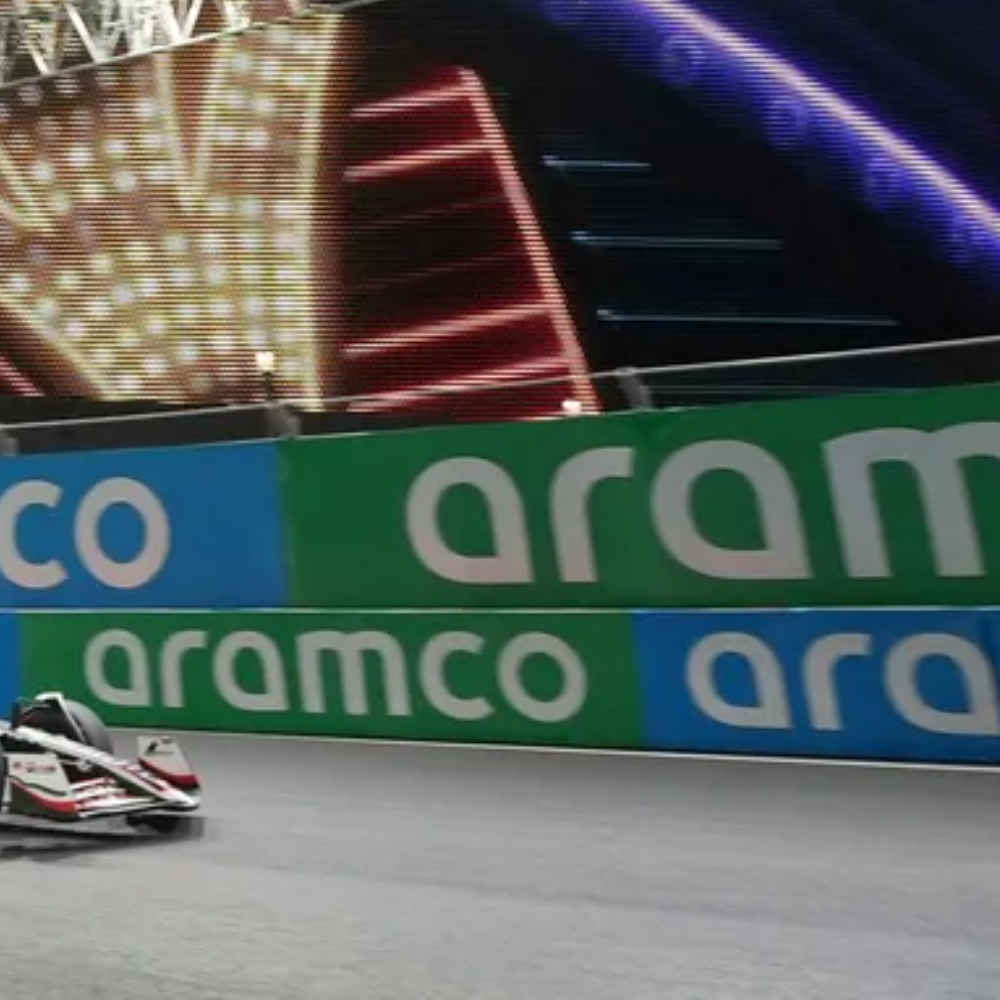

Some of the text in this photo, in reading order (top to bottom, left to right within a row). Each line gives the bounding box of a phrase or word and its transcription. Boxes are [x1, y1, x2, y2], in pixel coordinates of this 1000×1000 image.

[405, 421, 1000, 585] aram
[82, 629, 588, 724] aramco
[685, 632, 1000, 736] ara
